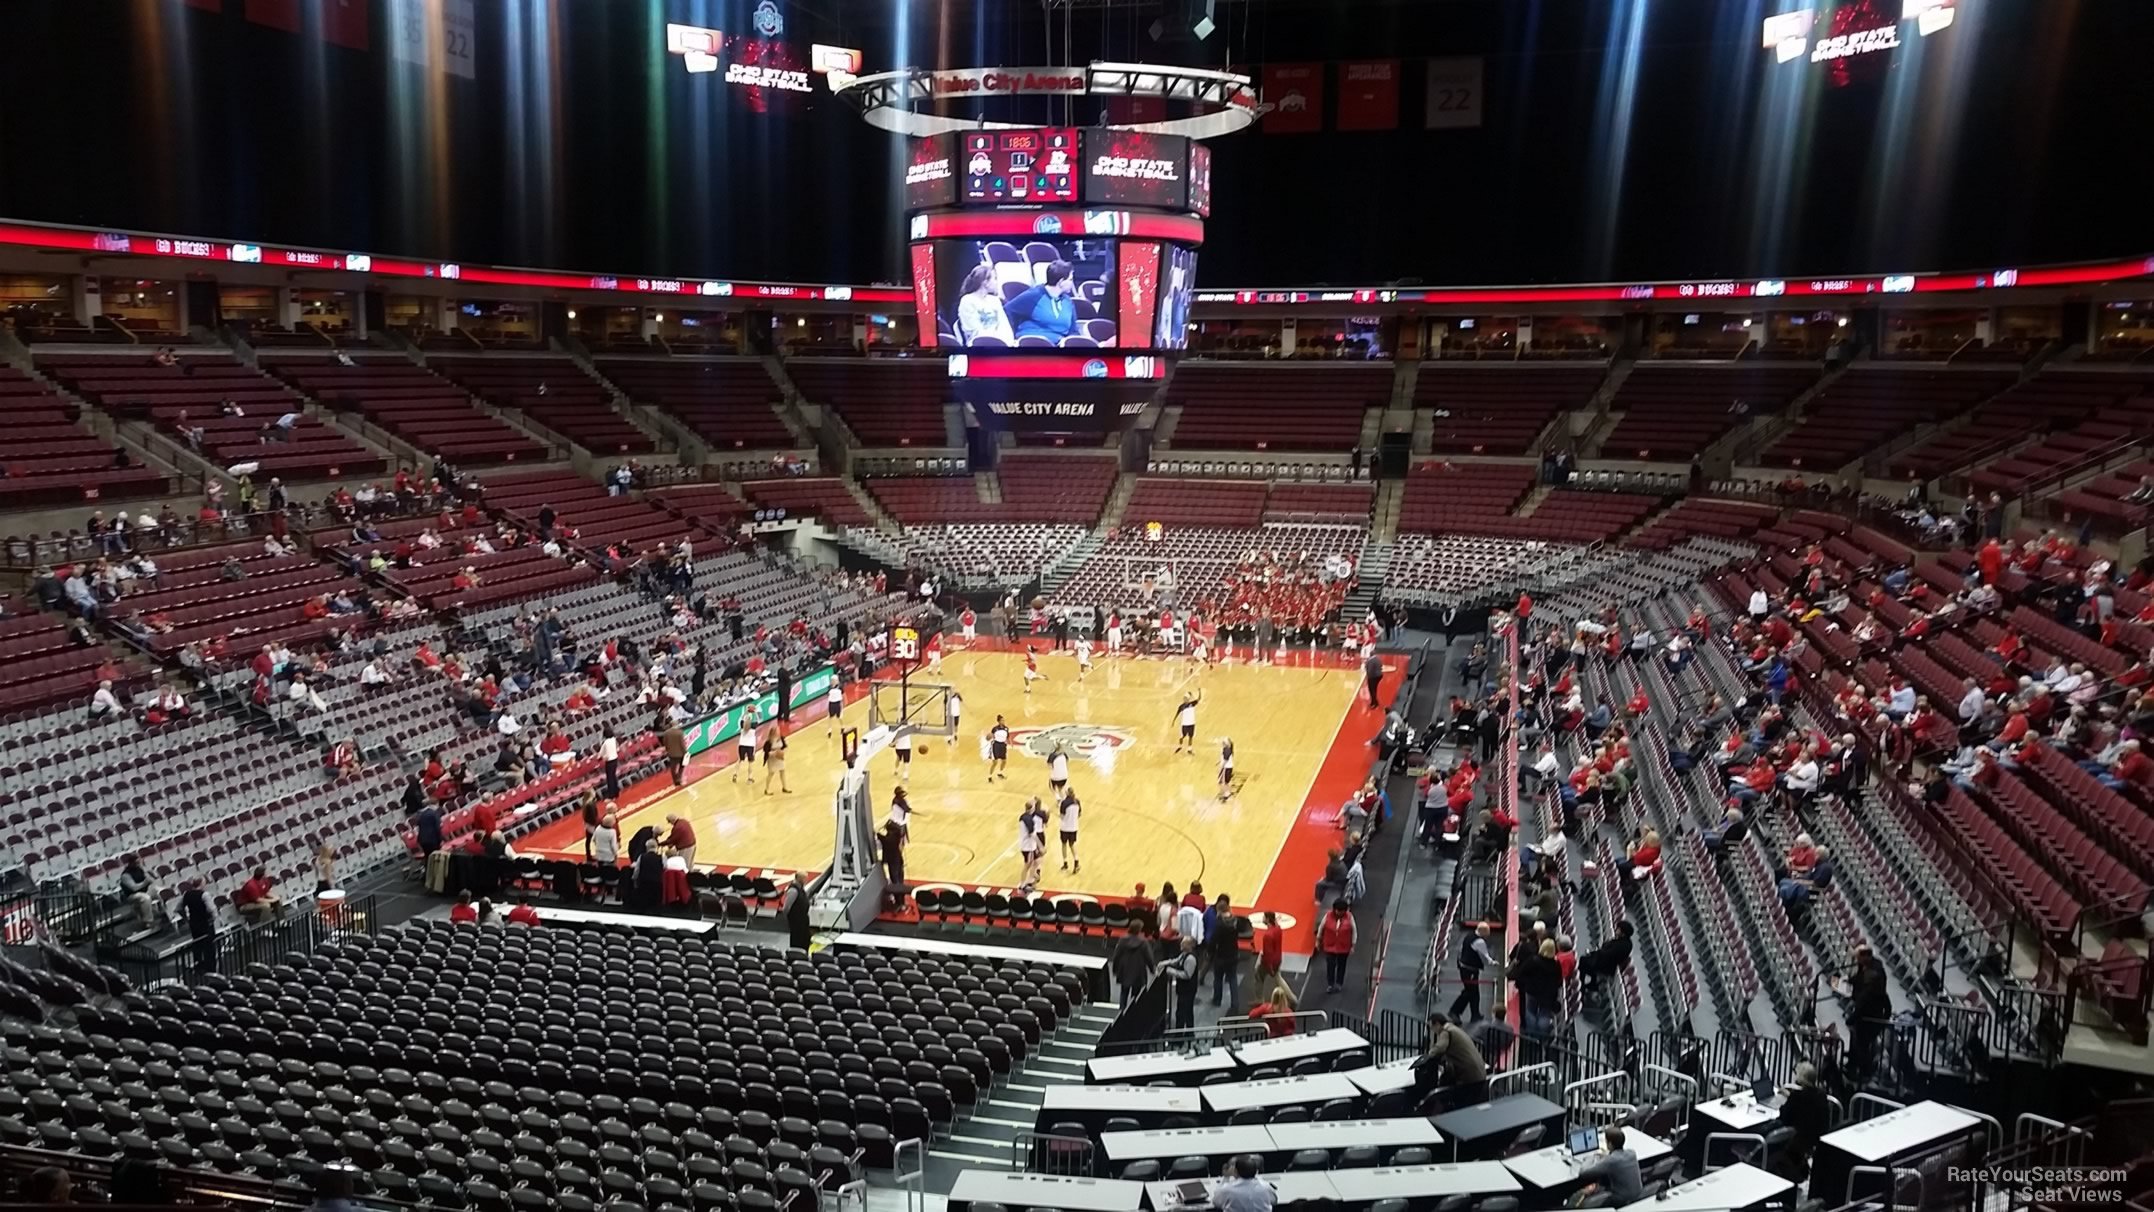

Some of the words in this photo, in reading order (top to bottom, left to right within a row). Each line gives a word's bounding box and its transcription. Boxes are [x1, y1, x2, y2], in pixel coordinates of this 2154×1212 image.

[446, 29, 469, 59] 22
[1816, 34, 1848, 51] OHIO
[1848, 25, 1897, 46] STATE
[1811, 40, 1901, 63] BASKETBALL
[725, 72, 813, 92] BASKETBALL
[729, 64, 762, 77] OHIO
[763, 68, 808, 83] STATE
[982, 72, 1022, 93] City
[1023, 73, 1084, 90] Arena
[1438, 88, 1472, 111] 22
[925, 159, 949, 173] STATE
[1092, 164, 1179, 181] BASKETBALL
[1097, 156, 1129, 168] OHIO
[1130, 158, 1174, 171] STATE
[156, 238, 171, 253] GO
[988, 402, 1022, 415] VALUE
[1023, 402, 1052, 415] CITY
[1054, 403, 1095, 416] ARENA
[894, 639, 916, 659] 30
